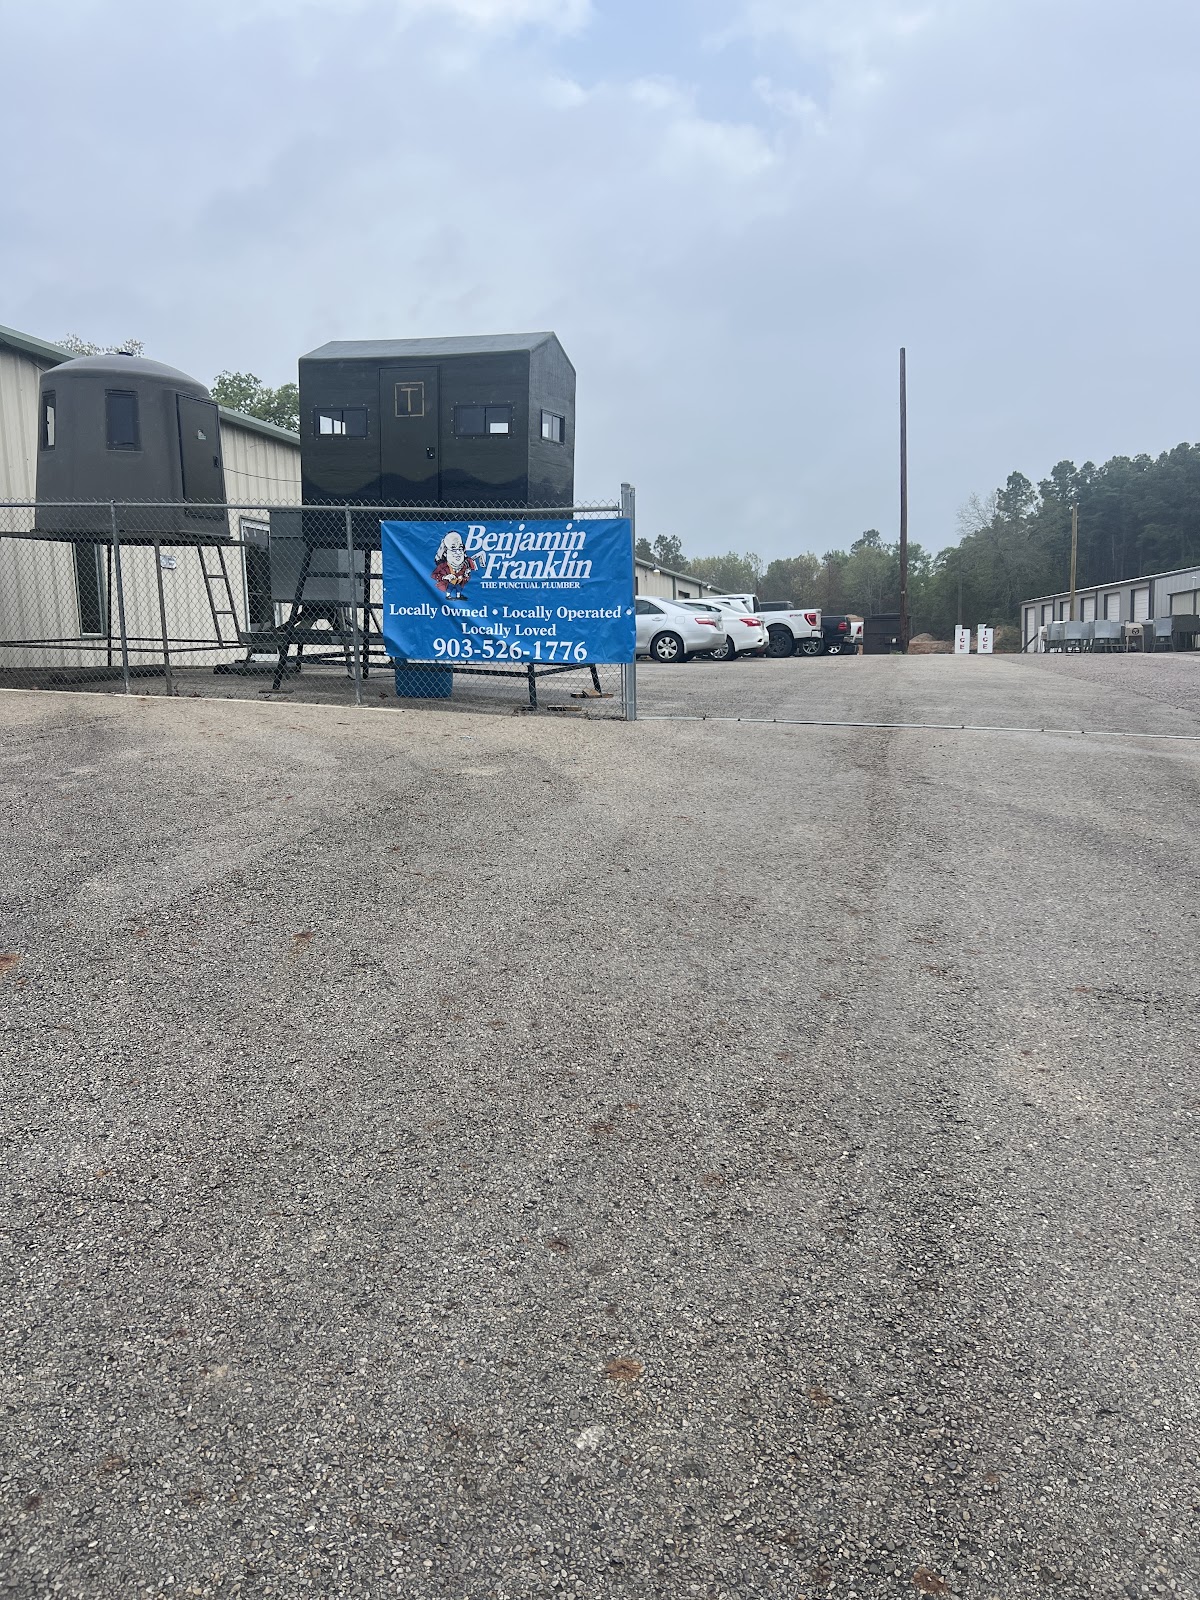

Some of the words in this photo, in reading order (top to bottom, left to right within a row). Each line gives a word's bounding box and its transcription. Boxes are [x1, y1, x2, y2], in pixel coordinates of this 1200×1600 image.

[466, 523, 587, 558] Benjamin
[481, 550, 592, 579] Franklin
[389, 603, 437, 618] Locally
[442, 605, 488, 617] Owned
[503, 606, 552, 620] Locally
[556, 606, 621, 621] Operated
[461, 623, 511, 638] Locally
[515, 624, 556, 636] Loved
[433, 639, 587, 661] 903-526-1776
